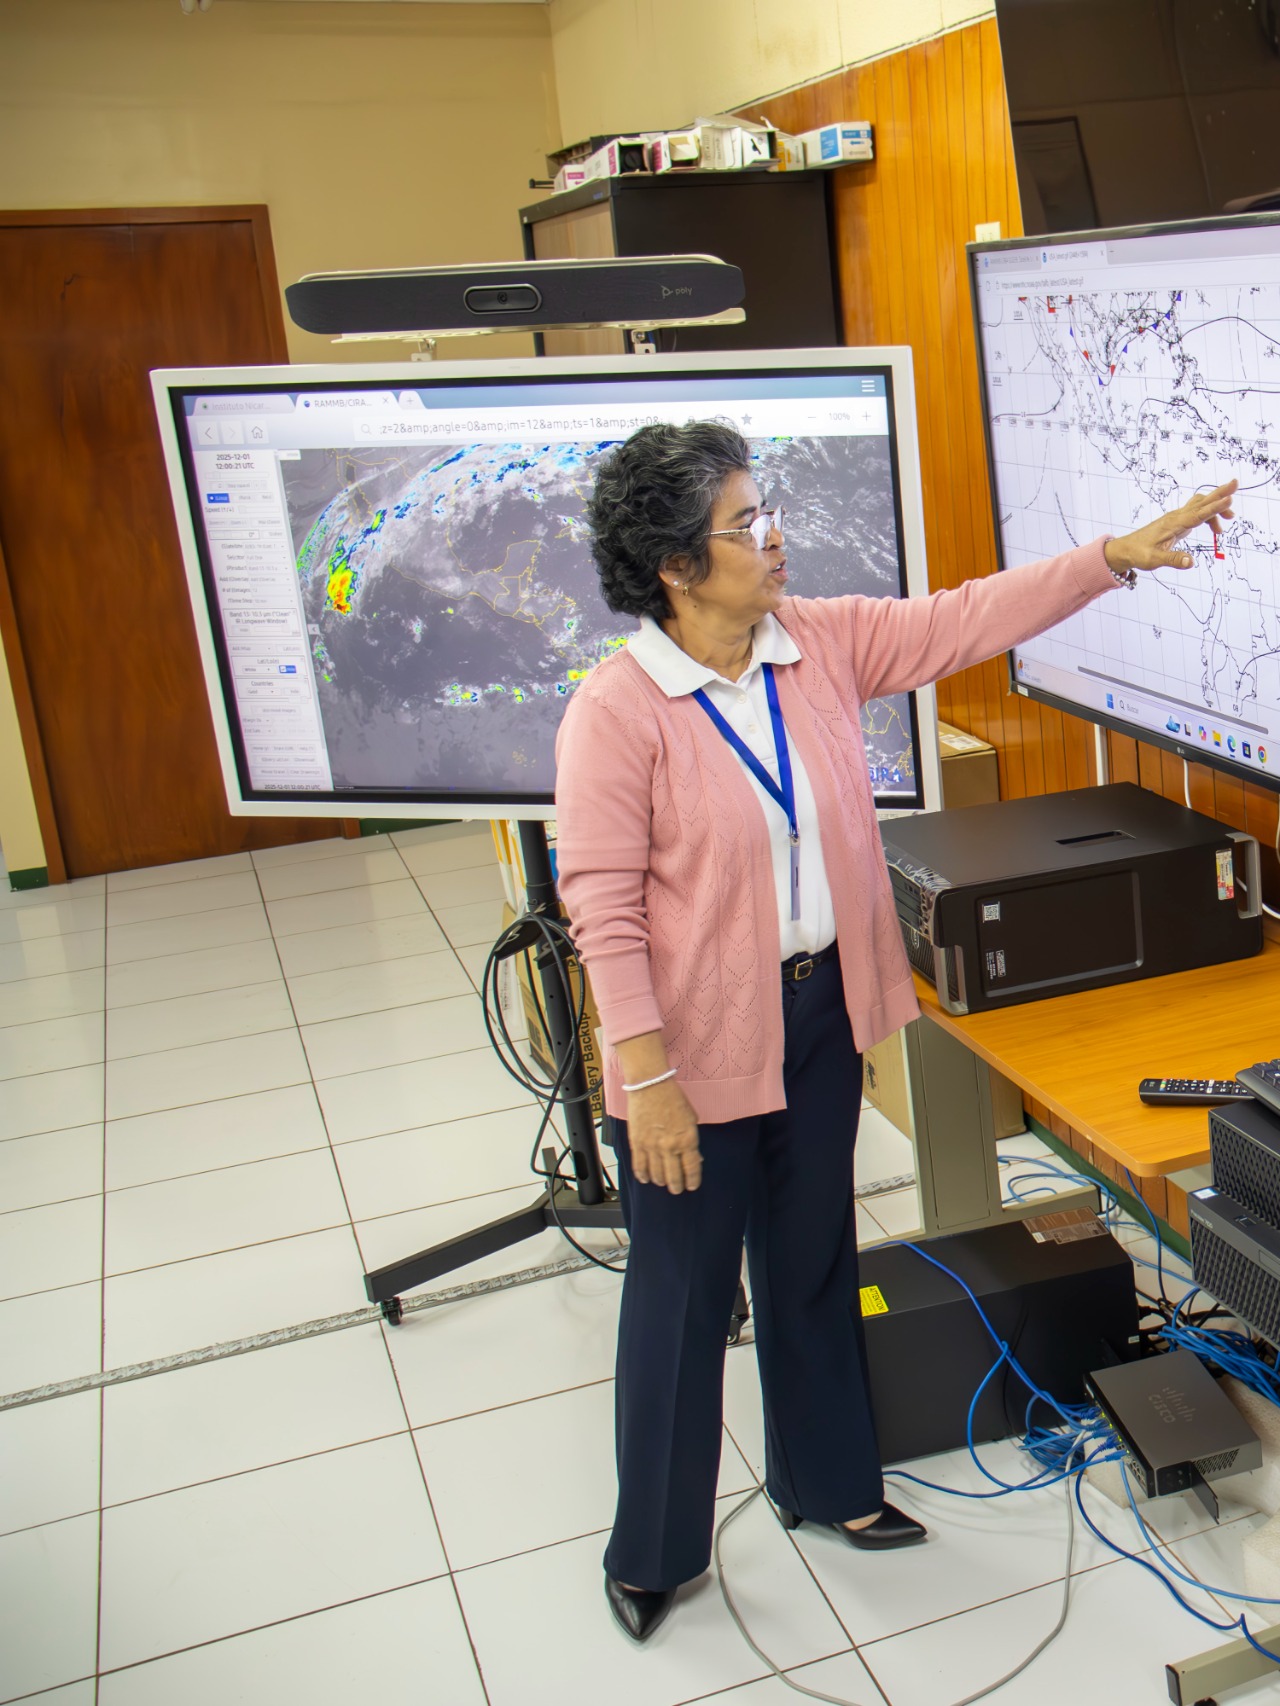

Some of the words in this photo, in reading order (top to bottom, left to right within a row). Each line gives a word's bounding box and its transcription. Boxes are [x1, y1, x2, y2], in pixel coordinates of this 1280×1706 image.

[675, 286, 693, 296] poly
[828, 411, 851, 422] 100%
[242, 462, 255, 470] UTC
[579, 1012, 594, 1062] Backup
